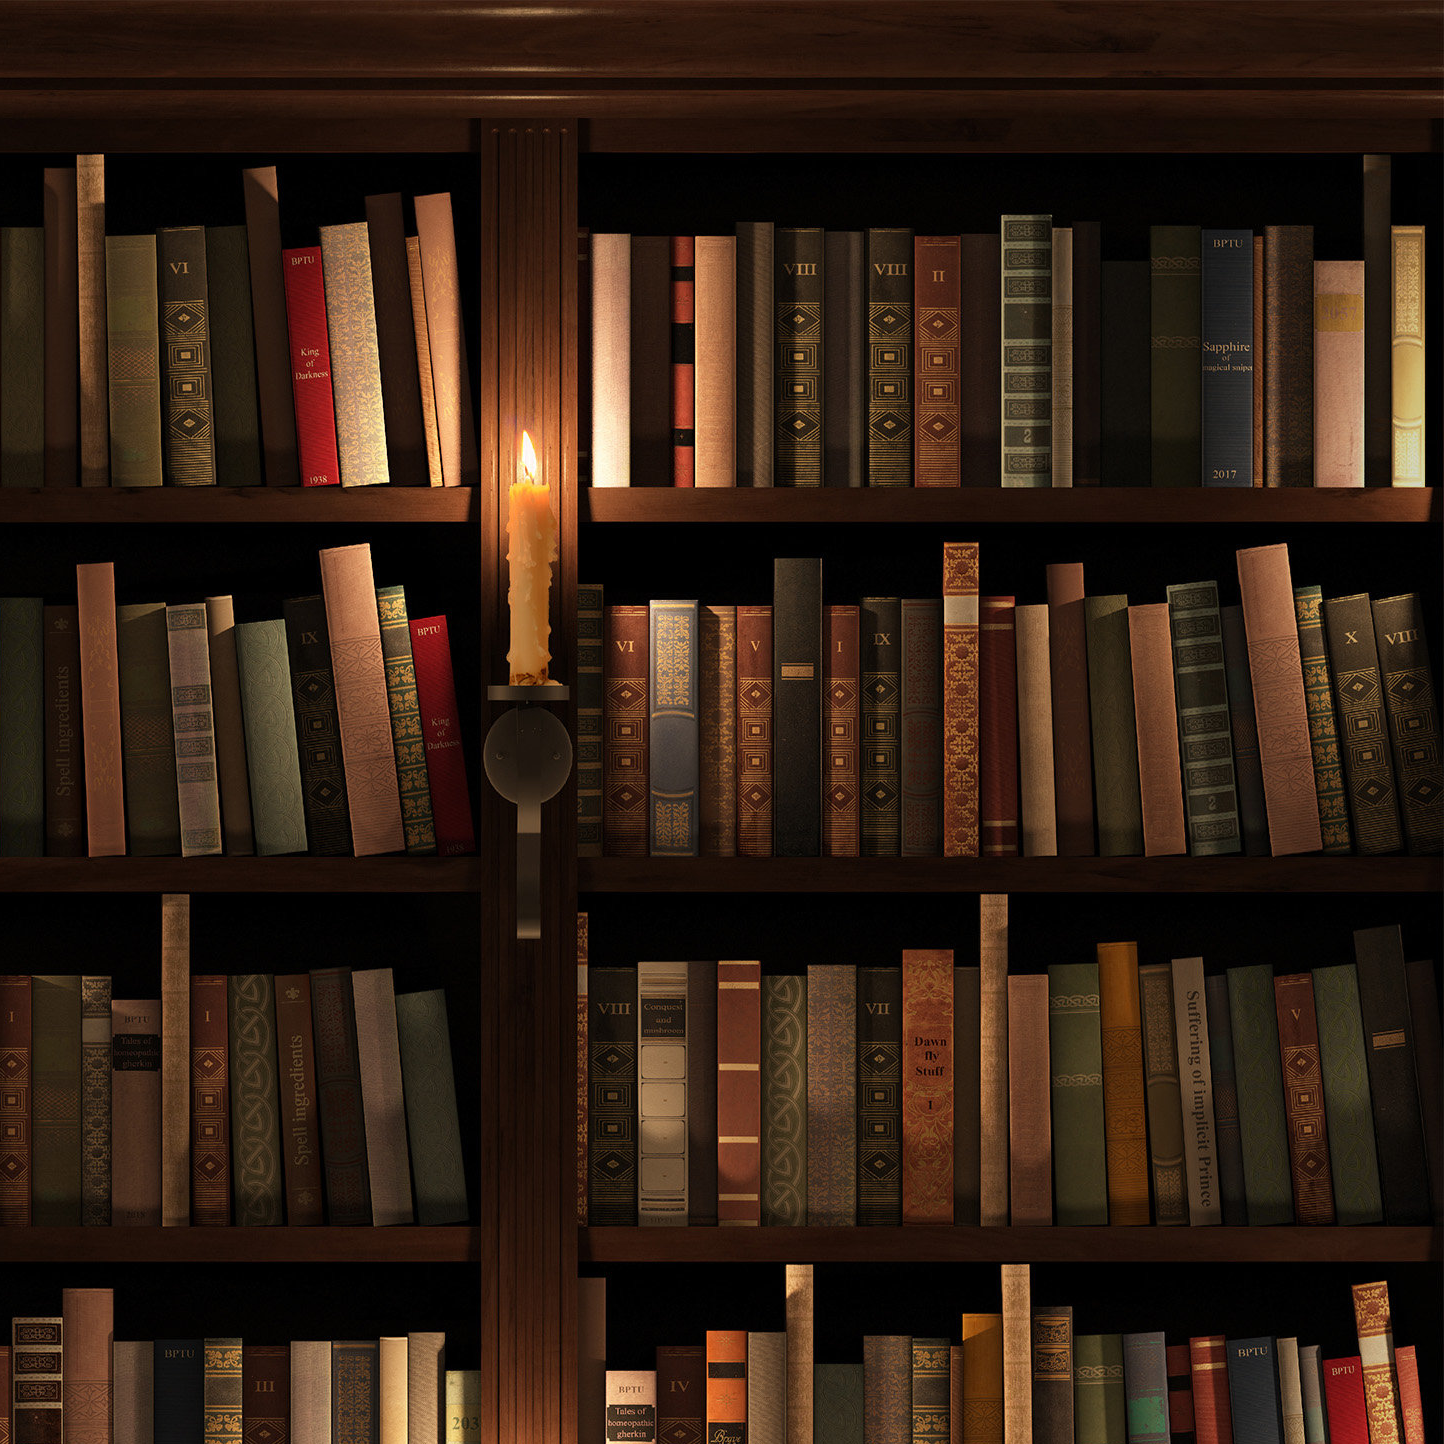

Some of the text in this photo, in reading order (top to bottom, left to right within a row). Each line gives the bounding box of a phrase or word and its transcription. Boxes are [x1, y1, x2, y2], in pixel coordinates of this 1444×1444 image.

[1212, 238, 1243, 248] BPTU
[291, 255, 315, 265] BPTU
[169, 261, 190, 275] VI
[782, 263, 817, 276] VIII
[873, 263, 908, 276] VIII
[932, 270, 945, 283] II
[300, 347, 320, 358] King
[1202, 342, 1251, 355] Sapphire
[305, 358, 314, 368] of
[1202, 364, 1229, 372] magical
[295, 370, 329, 381] Darkness
[308, 474, 328, 484] 1938
[1212, 470, 1237, 480] 2017
[416, 624, 441, 636] BPTU
[300, 631, 319, 645] IX
[873, 634, 891, 646] IX
[1345, 631, 1359, 645] X
[1384, 628, 1420, 646] VIII
[616, 641, 635, 653] VI
[750, 641, 760, 653] V
[836, 641, 843, 653] I
[430, 716, 451, 728] King
[55, 665, 75, 797] Spell ingredients
[435, 729, 446, 739] of
[425, 739, 460, 752] Darkness
[597, 1002, 631, 1015] VIII
[643, 1002, 683, 1012] Conquest
[865, 1002, 891, 1015] VII
[9, 1011, 15, 1022] I
[124, 1015, 150, 1024] BPTU
[205, 1011, 211, 1022] I
[656, 1016, 672, 1024] and
[1290, 1008, 1302, 1021] V
[643, 1027, 684, 1035] mushroom
[121, 1037, 152, 1045] Tales of
[913, 1037, 947, 1047] Dawn
[924, 1051, 939, 1063] fly
[122, 1059, 153, 1070] gherkin
[915, 1066, 945, 1077] Stuff
[292, 1034, 311, 1166] Spell ingredients
[1186, 990, 1211, 1207] Suffering of implicit Prince
[164, 1348, 195, 1359] BPTU
[1237, 1346, 1268, 1358] BPTU
[1331, 1365, 1354, 1376] BPTU
[254, 1380, 276, 1393] III
[618, 1386, 644, 1395] BPTU
[670, 1380, 690, 1393] IV
[614, 1407, 646, 1415] Tales of
[452, 1416, 480, 1430] 203
[607, 1419, 654, 1429] homeopathic
[616, 1430, 646, 1440] gherkin
[710, 1428, 742, 1444] Brave
